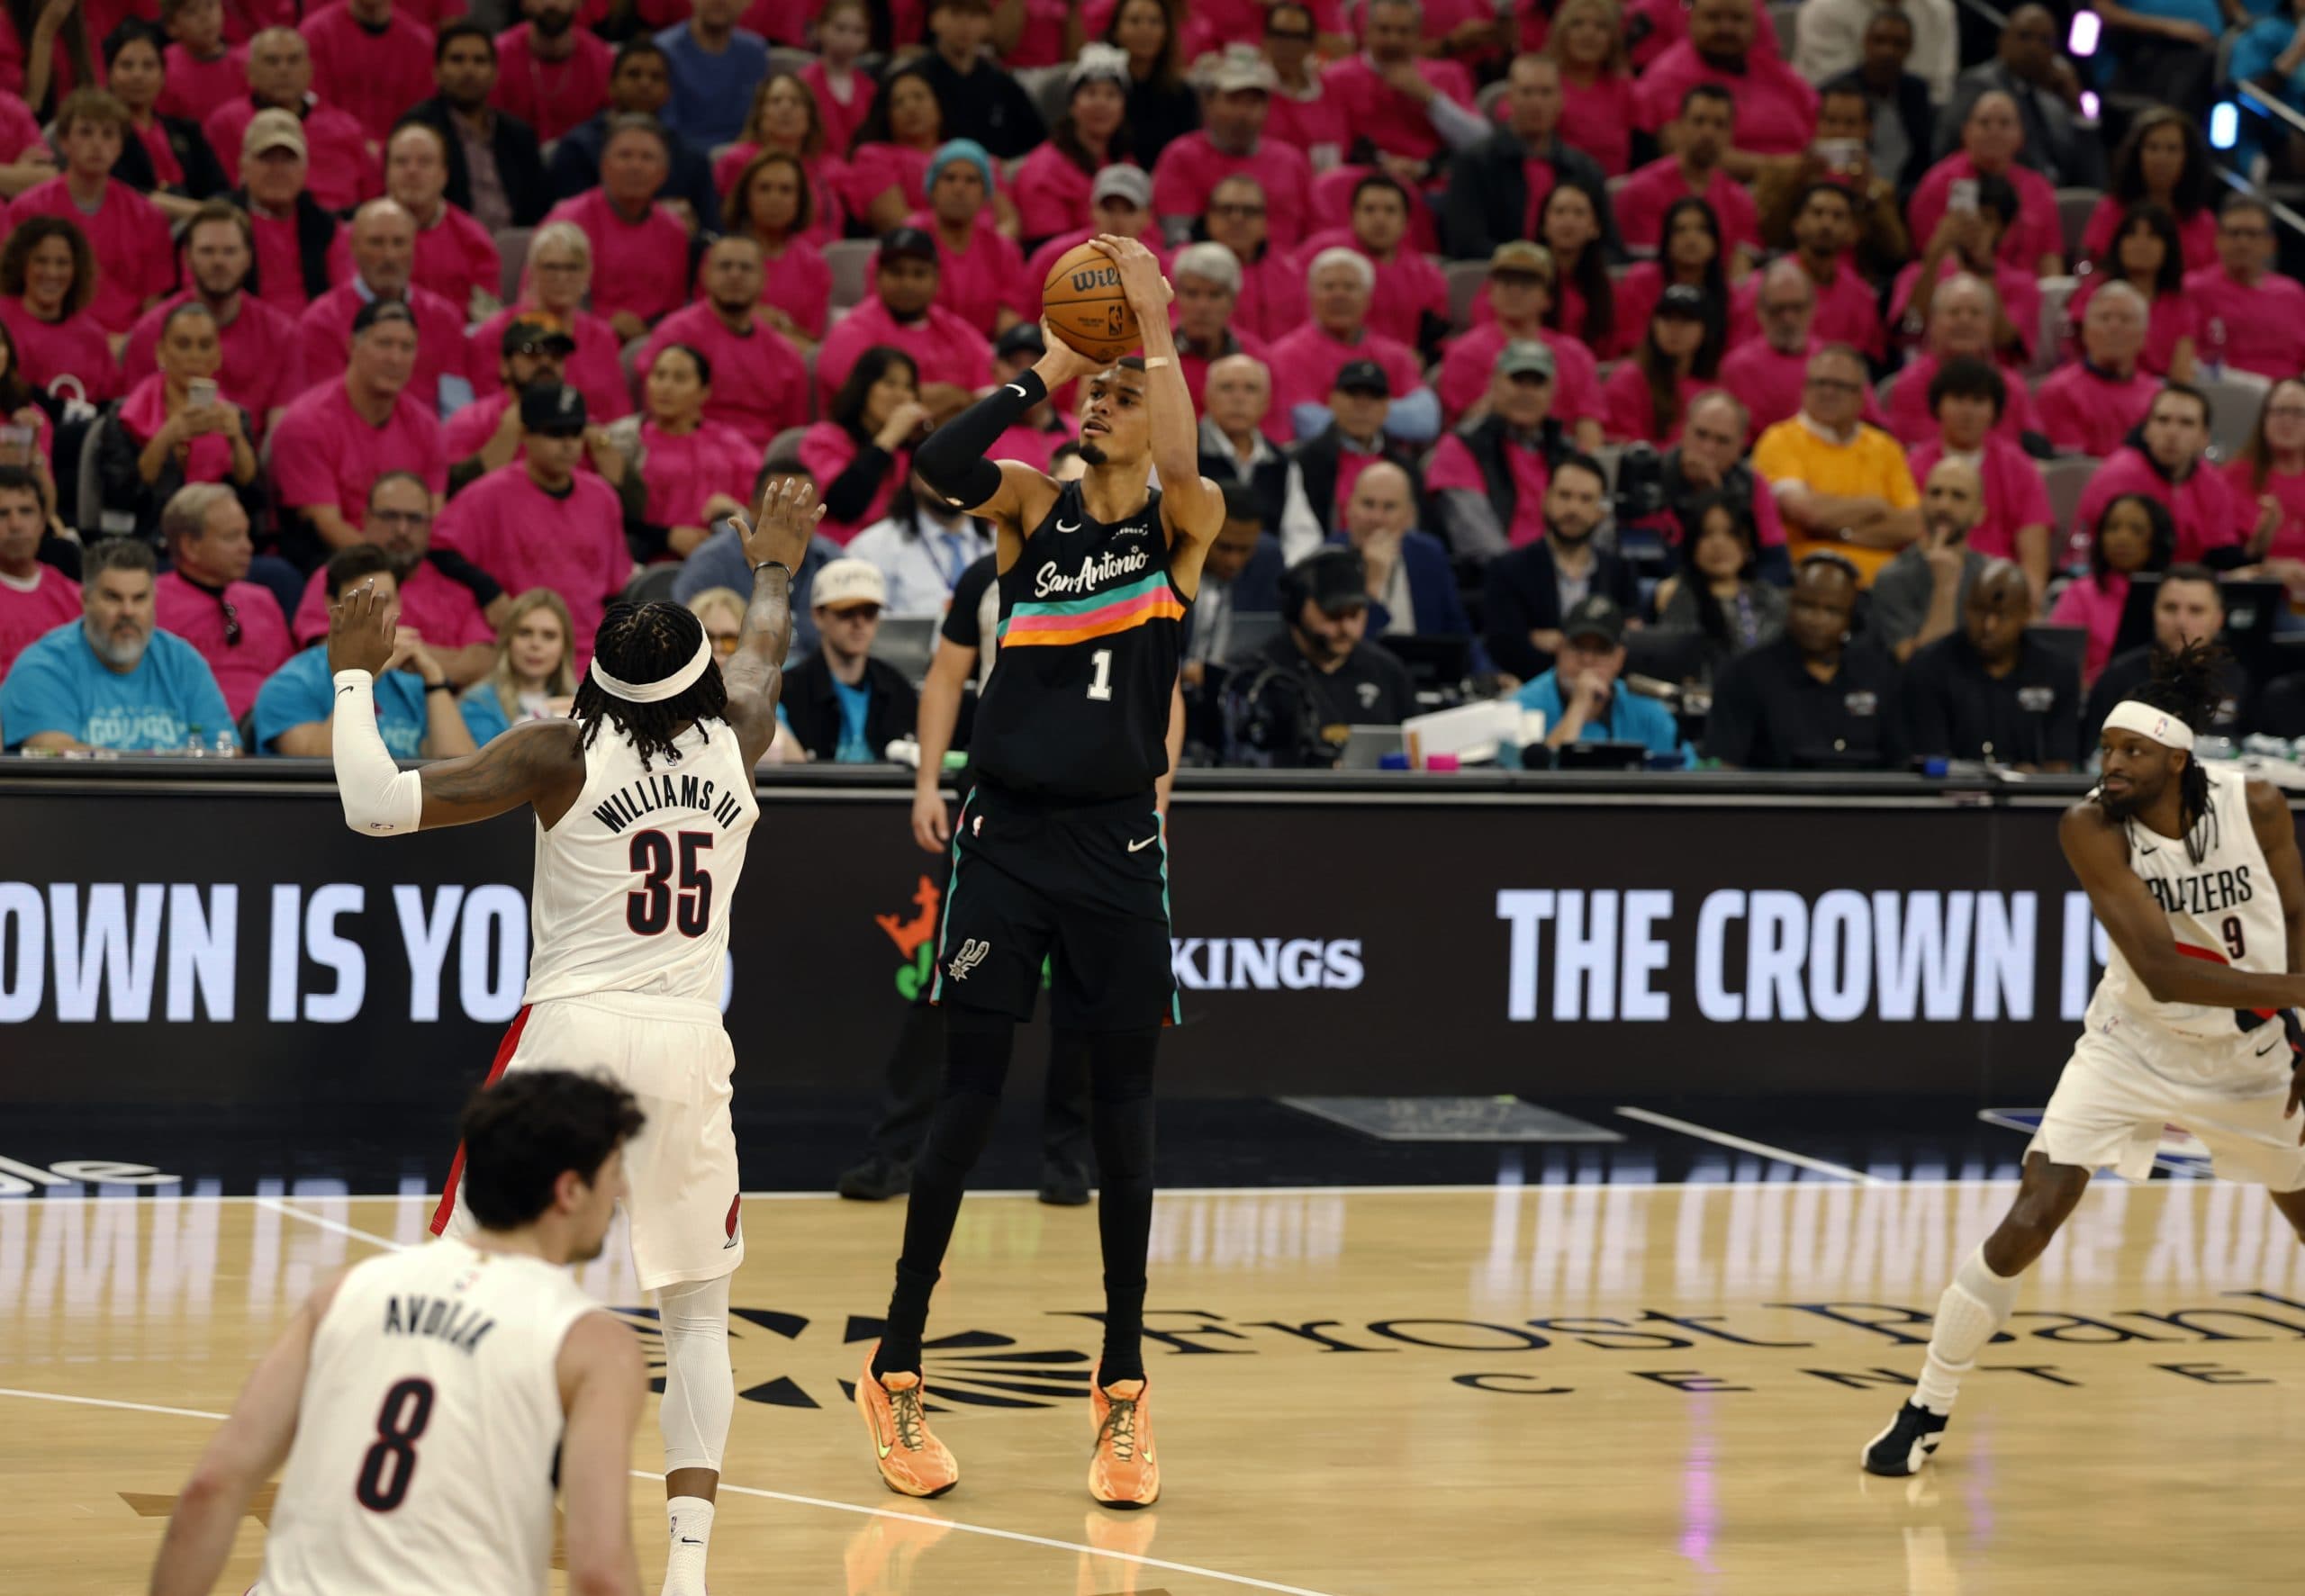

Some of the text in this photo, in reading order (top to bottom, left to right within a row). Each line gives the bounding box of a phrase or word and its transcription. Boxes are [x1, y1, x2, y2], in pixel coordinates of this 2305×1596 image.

[1071, 266, 1123, 293] Wil
[1087, 648, 1112, 701] 1
[592, 774, 742, 834] WILLIAMS III
[626, 828, 714, 939] 35
[0, 881, 529, 1023] OWN IS YO
[1170, 936, 1365, 990] KINGS
[1496, 888, 2110, 1023] THE CROWN I
[2221, 914, 2246, 960] 9
[1043, 1309, 1813, 1356] Frost
[356, 1375, 437, 1514] 8
